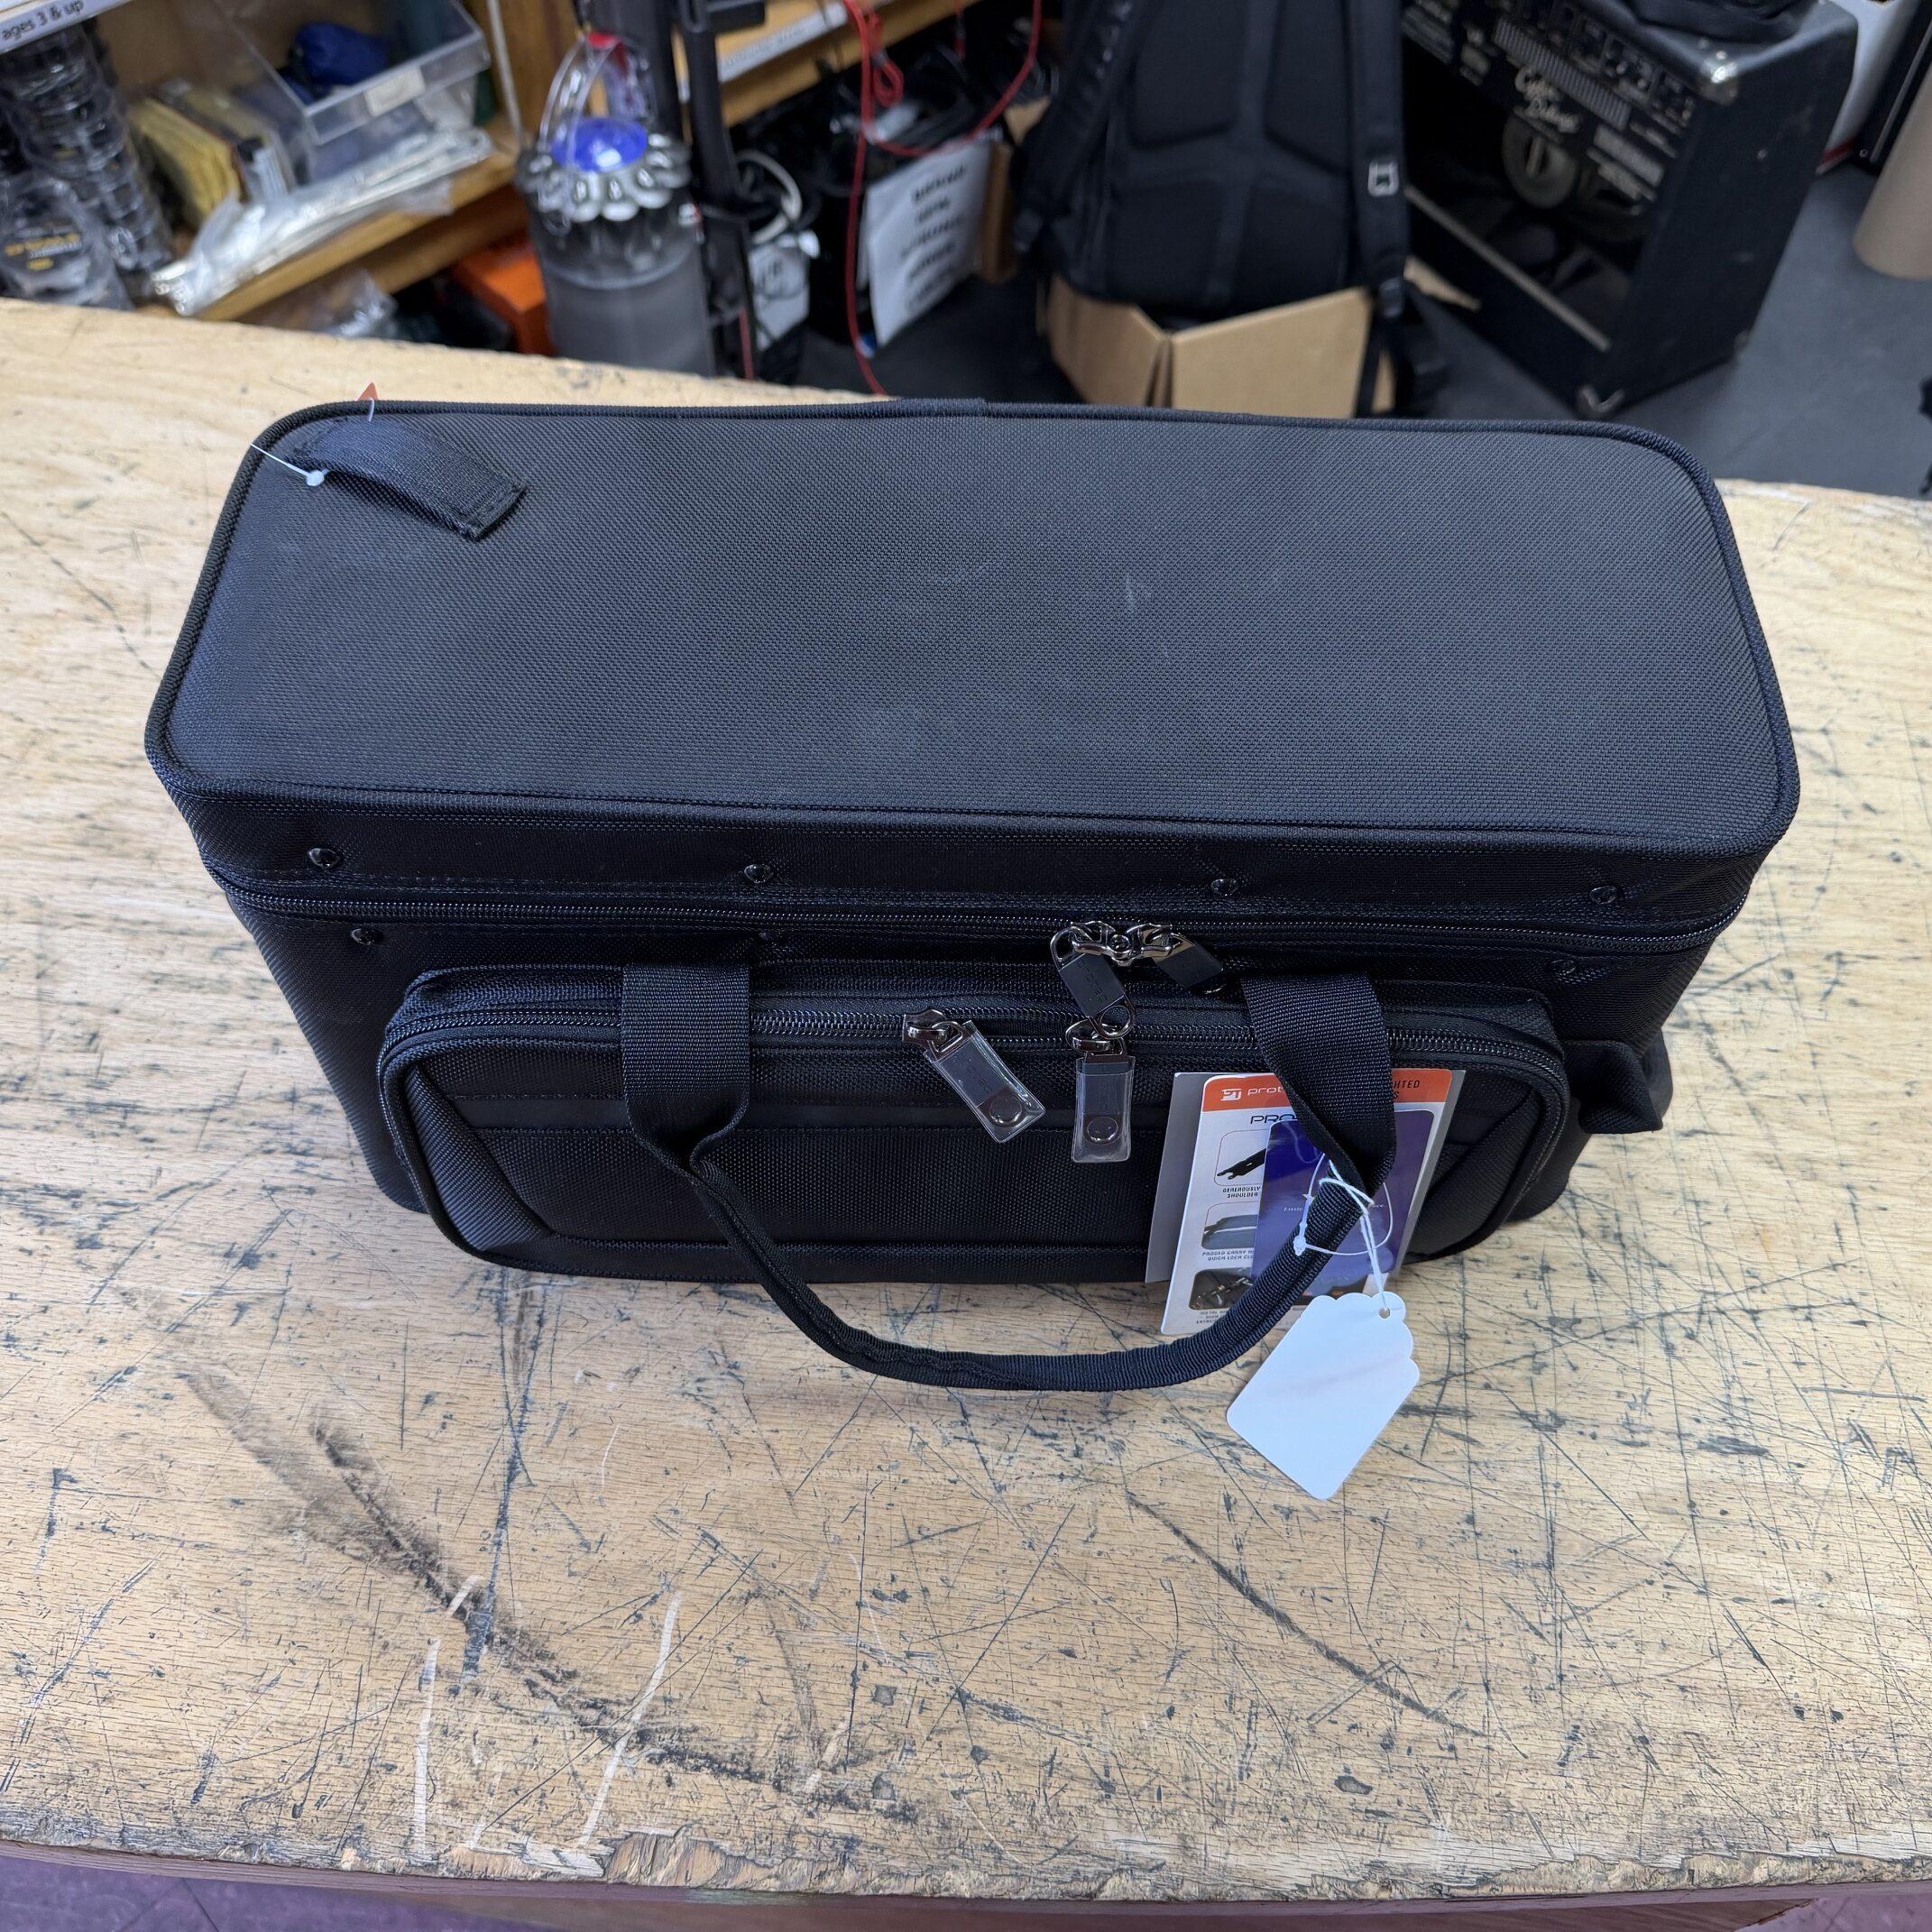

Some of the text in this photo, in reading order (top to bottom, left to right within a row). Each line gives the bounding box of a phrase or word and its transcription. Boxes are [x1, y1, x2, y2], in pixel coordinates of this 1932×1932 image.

[2, 20, 35, 40] ages
[37, 12, 48, 25] 3
[63, 0, 84, 15] up
